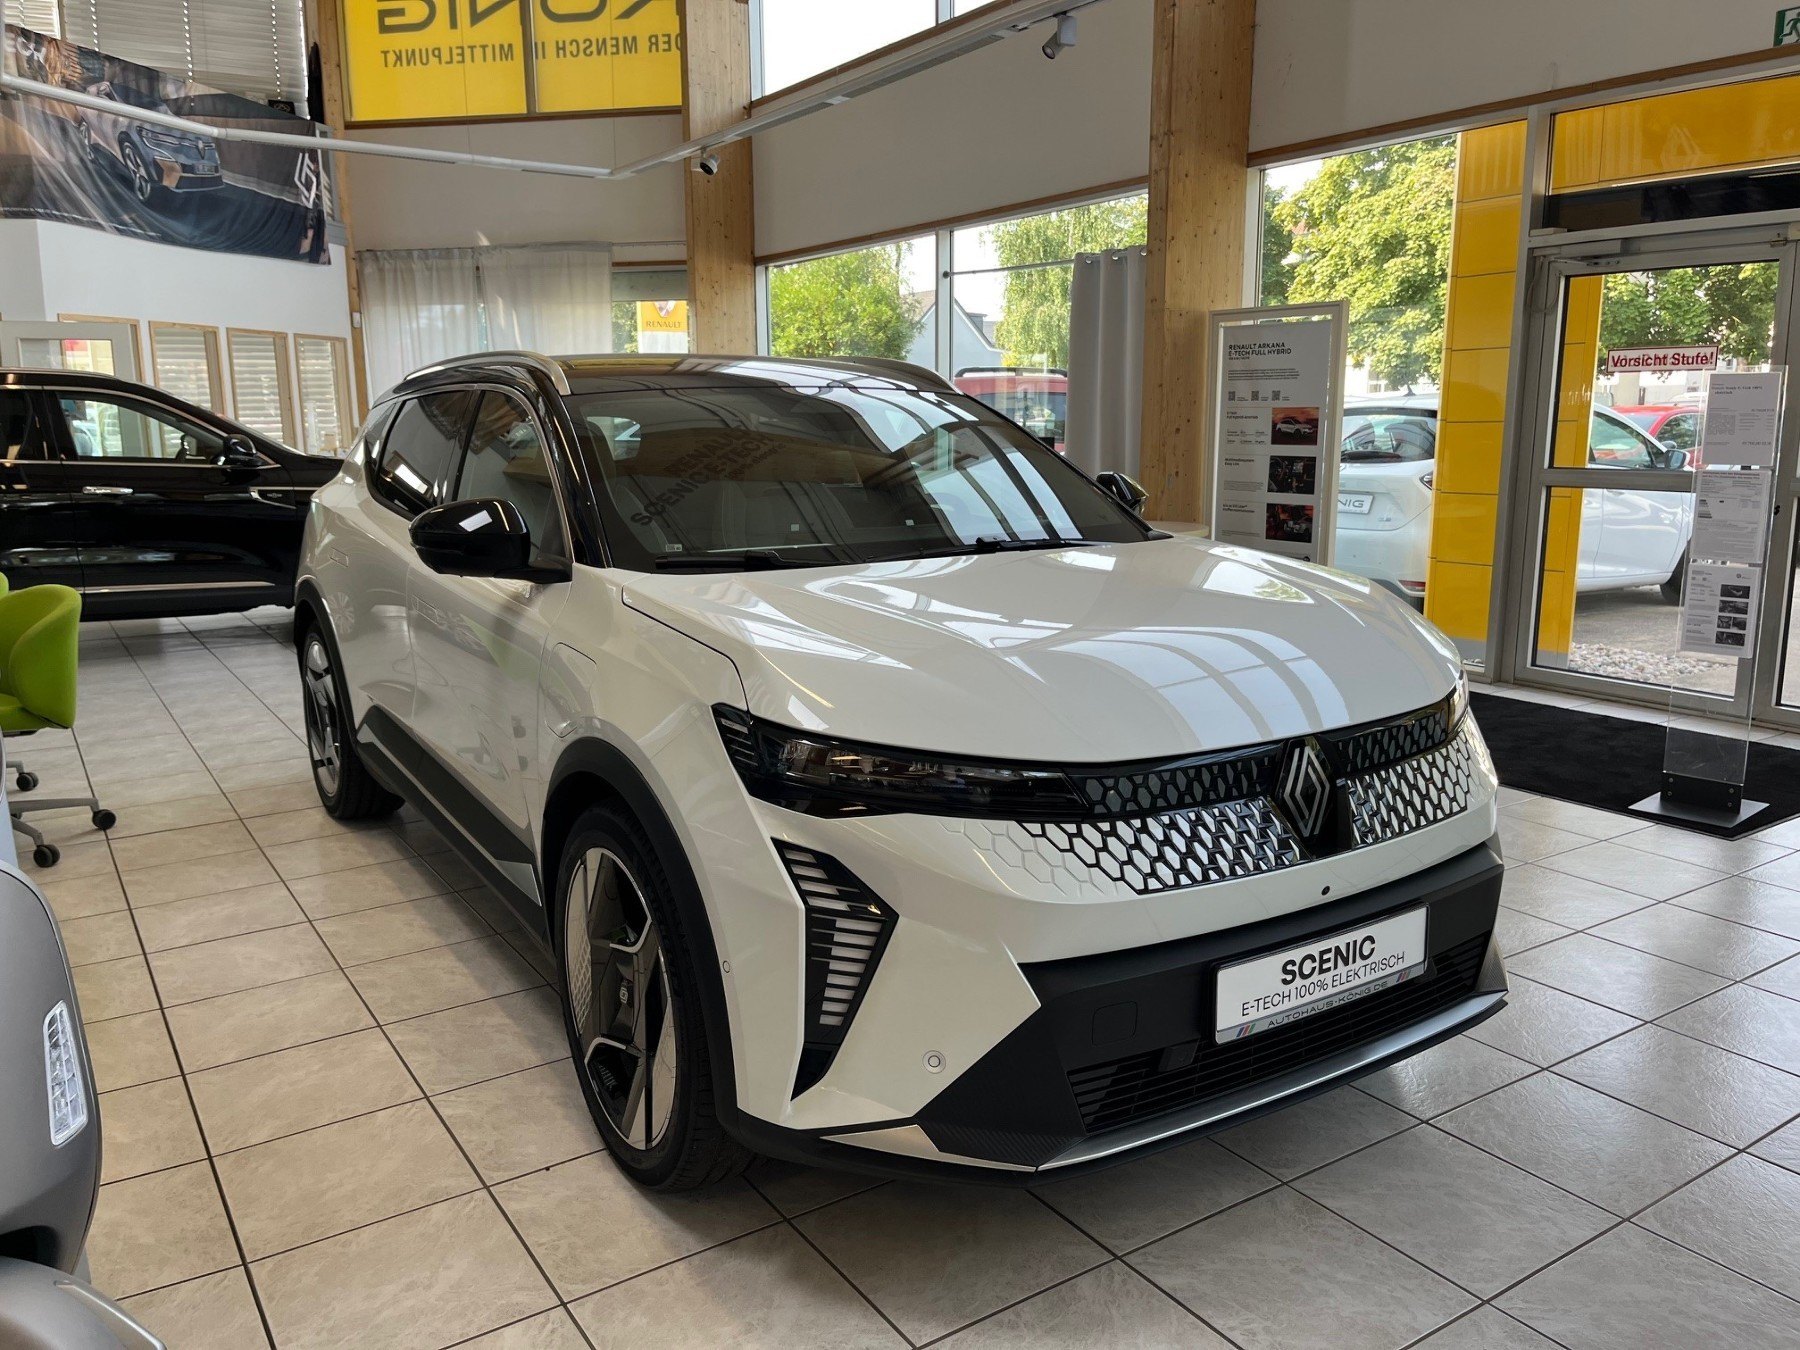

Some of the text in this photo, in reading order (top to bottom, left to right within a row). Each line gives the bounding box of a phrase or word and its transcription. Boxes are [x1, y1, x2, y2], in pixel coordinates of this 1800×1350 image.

[1611, 352, 1714, 368] Vorsicht Stufe!
[1241, 951, 1405, 1017] E-TECH 100% ELEKTRISCH
[1281, 935, 1376, 986] SCENIC
